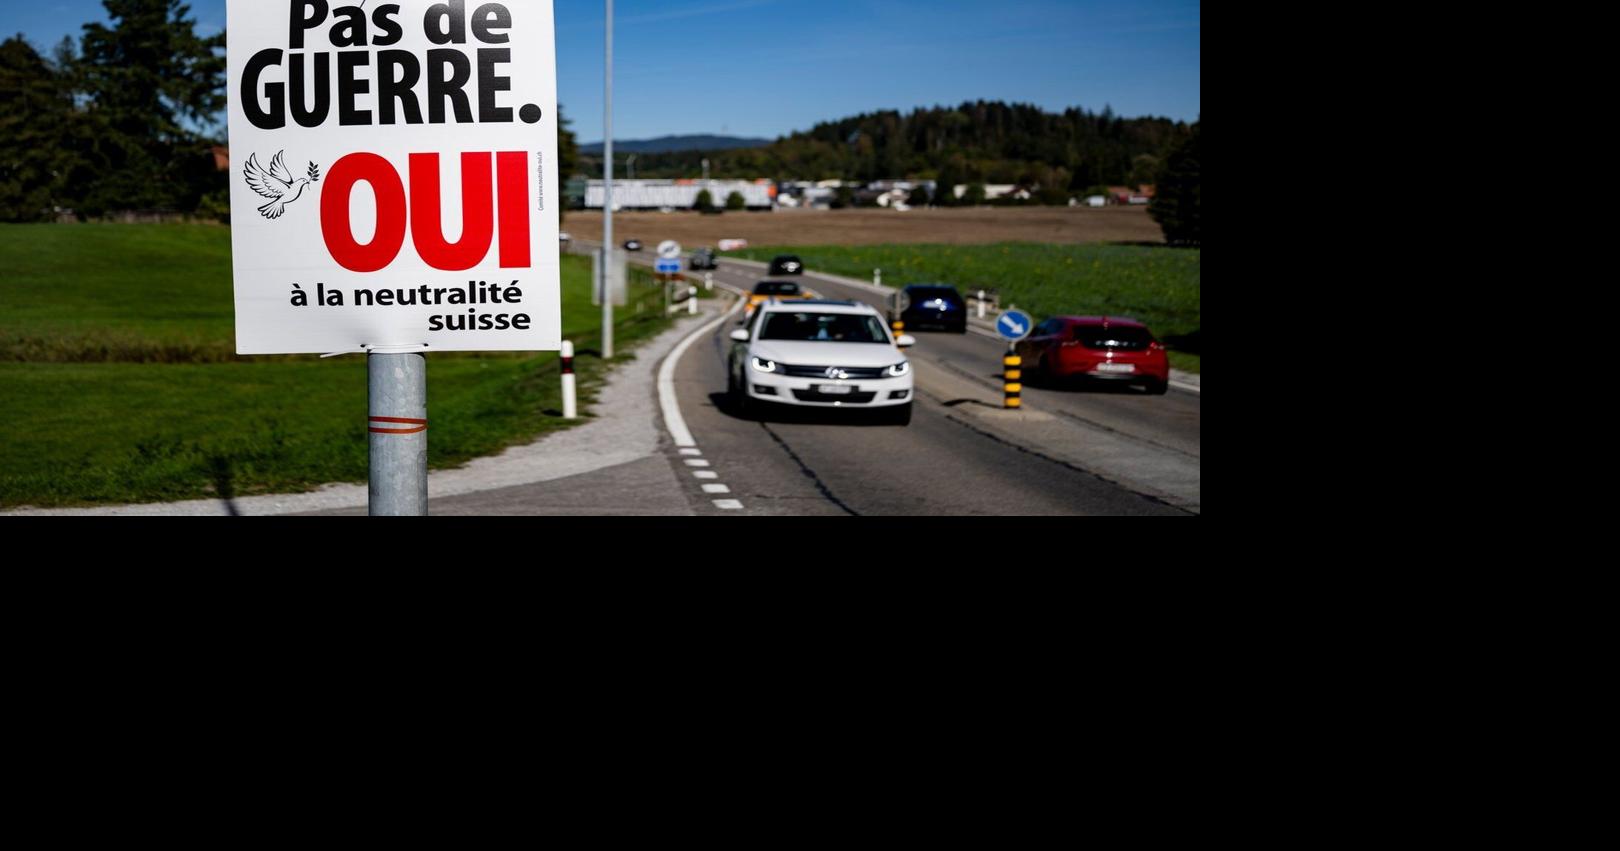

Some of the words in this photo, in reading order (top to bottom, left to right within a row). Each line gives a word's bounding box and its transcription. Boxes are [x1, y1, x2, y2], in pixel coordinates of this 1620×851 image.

[289, 0, 403, 48] Pas
[423, 0, 512, 45] de
[241, 47, 541, 130] GUERRE.
[320, 151, 531, 272] OUI
[291, 284, 307, 306] à
[317, 283, 343, 306] la
[355, 280, 522, 305] neutralité
[429, 308, 530, 331] suisse
